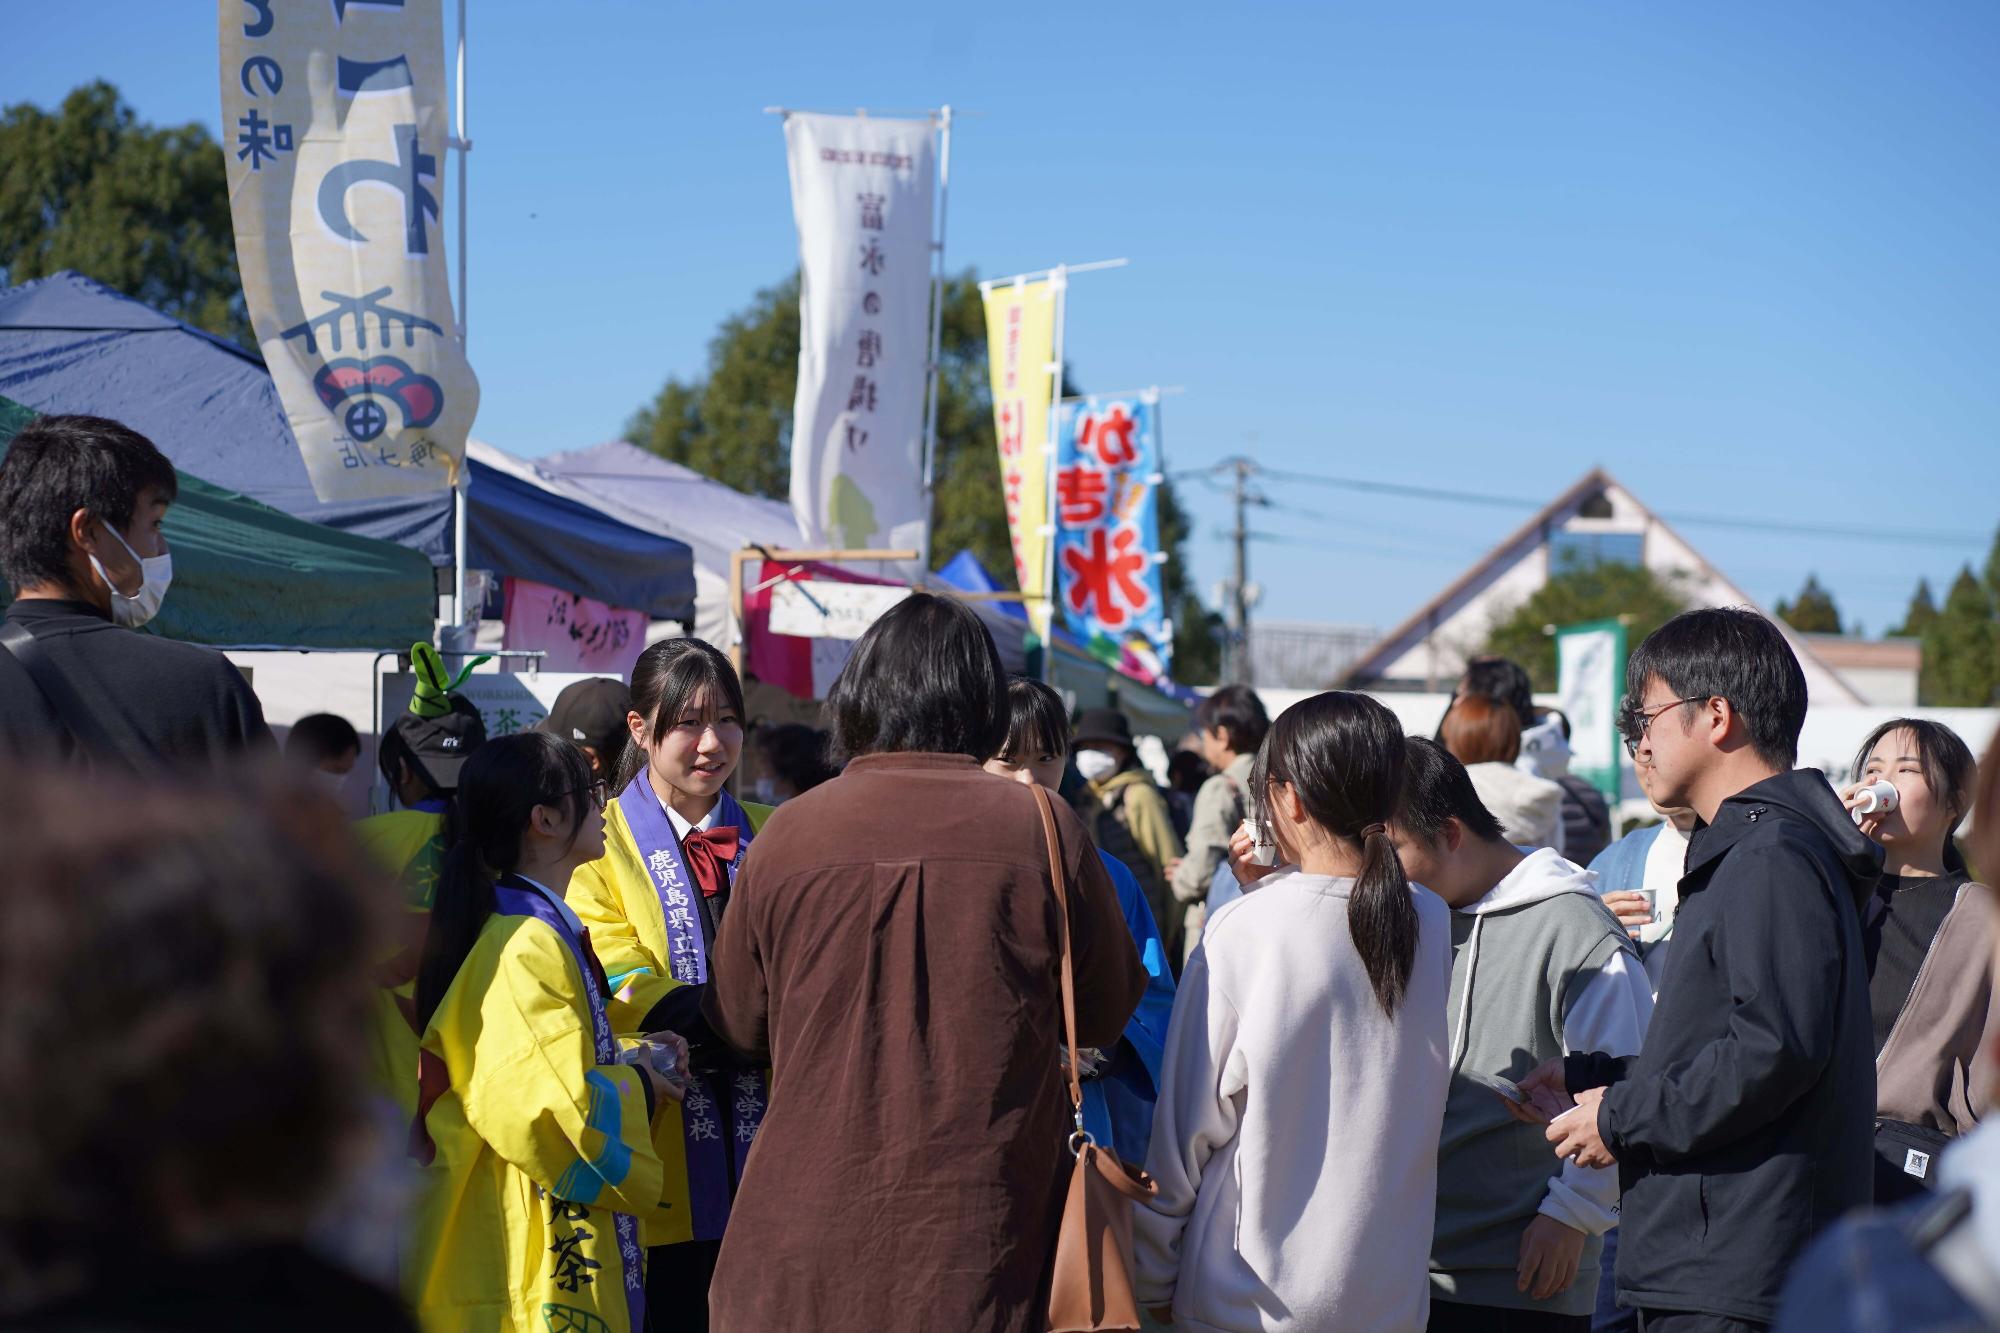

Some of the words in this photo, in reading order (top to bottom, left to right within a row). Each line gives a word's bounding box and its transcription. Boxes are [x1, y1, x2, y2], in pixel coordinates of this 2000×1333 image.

[648, 849, 700, 983] 鹿児島県立薩
